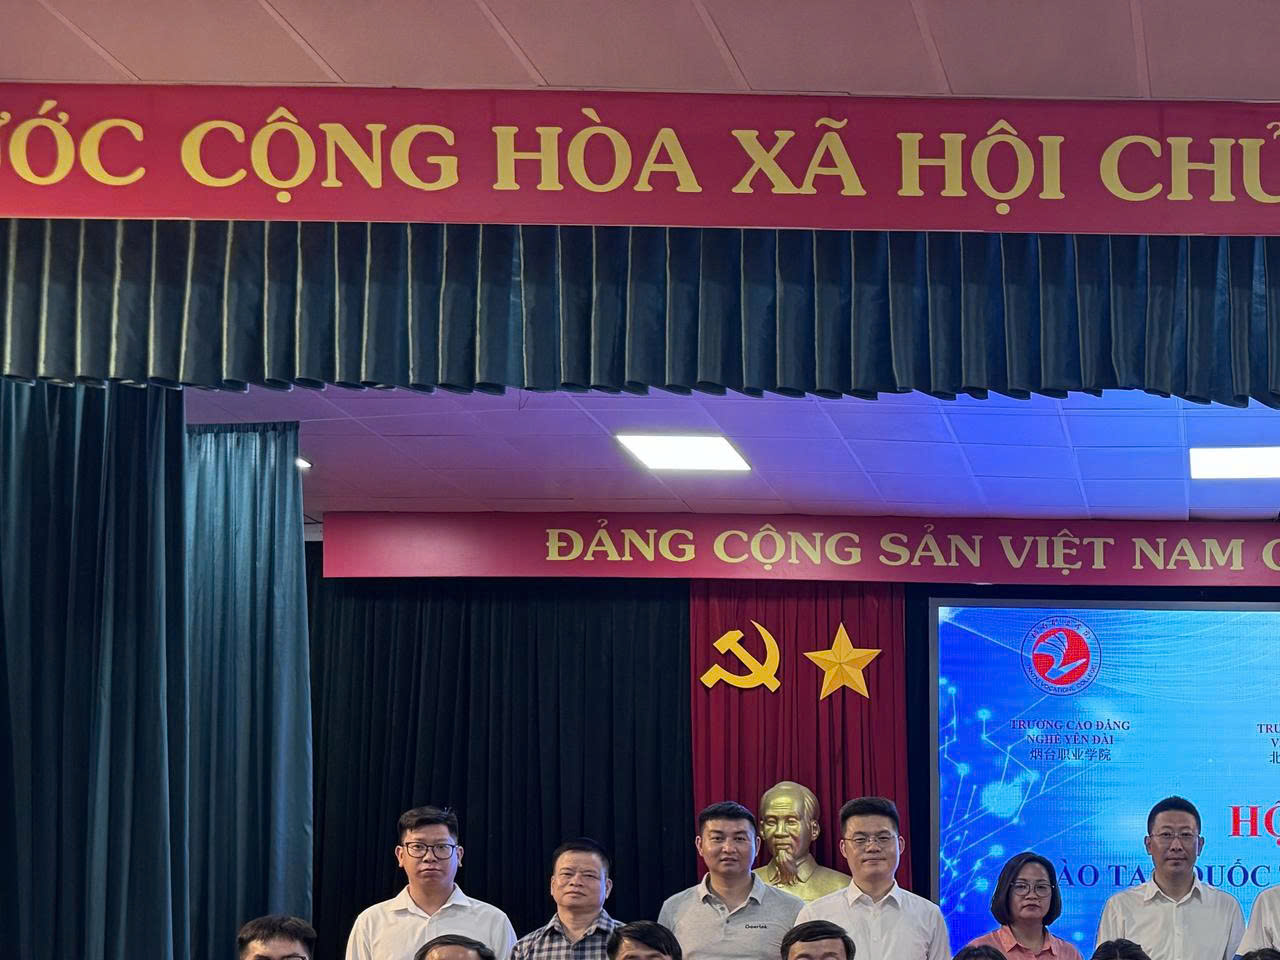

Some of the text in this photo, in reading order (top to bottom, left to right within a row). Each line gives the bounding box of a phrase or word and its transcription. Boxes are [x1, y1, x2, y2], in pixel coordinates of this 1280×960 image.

[0, 100, 146, 187] ỚC
[181, 106, 460, 203] CỘNG
[492, 108, 702, 193] HÒA
[731, 117, 866, 197] XÃ
[896, 119, 1066, 215] HỘI
[546, 518, 696, 563] ĐẢNG
[713, 526, 863, 571] CỘNG
[879, 524, 984, 567] SẢN
[999, 528, 1114, 575] VIỆT
[1132, 538, 1244, 570] NAM
[1066, 720, 1093, 731] CAO
[1065, 732, 1089, 744] YÊN
[1030, 747, 1112, 761] 烟台职业学院
[1057, 858, 1099, 886] ÀO
[1199, 858, 1271, 887] UỐC
